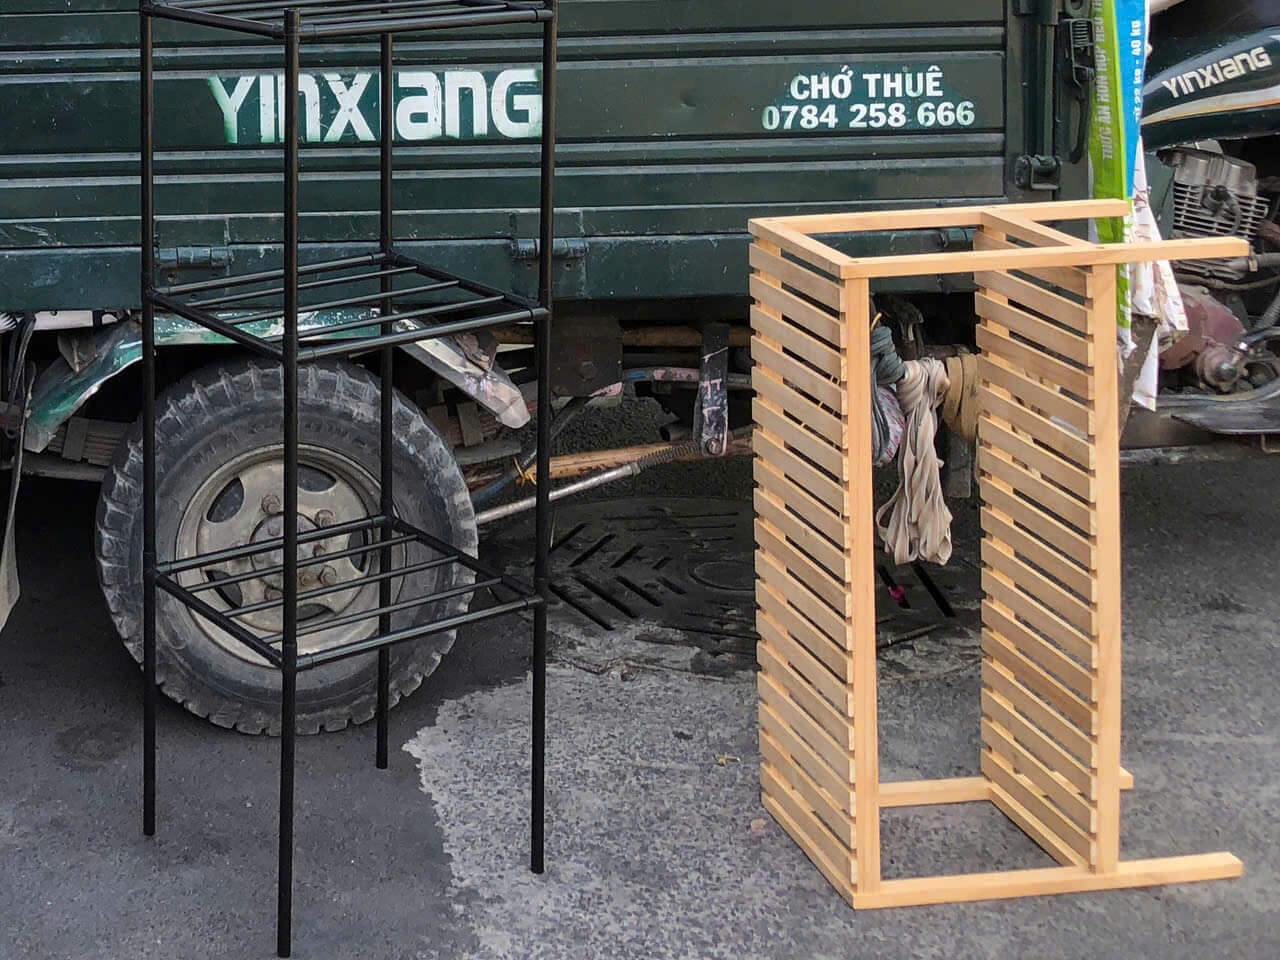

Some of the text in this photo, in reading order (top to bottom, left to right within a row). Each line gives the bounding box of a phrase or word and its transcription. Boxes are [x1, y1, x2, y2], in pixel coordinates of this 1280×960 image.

[862, 65, 943, 98] THUÊ
[762, 101, 975, 130] 0784 258 666
